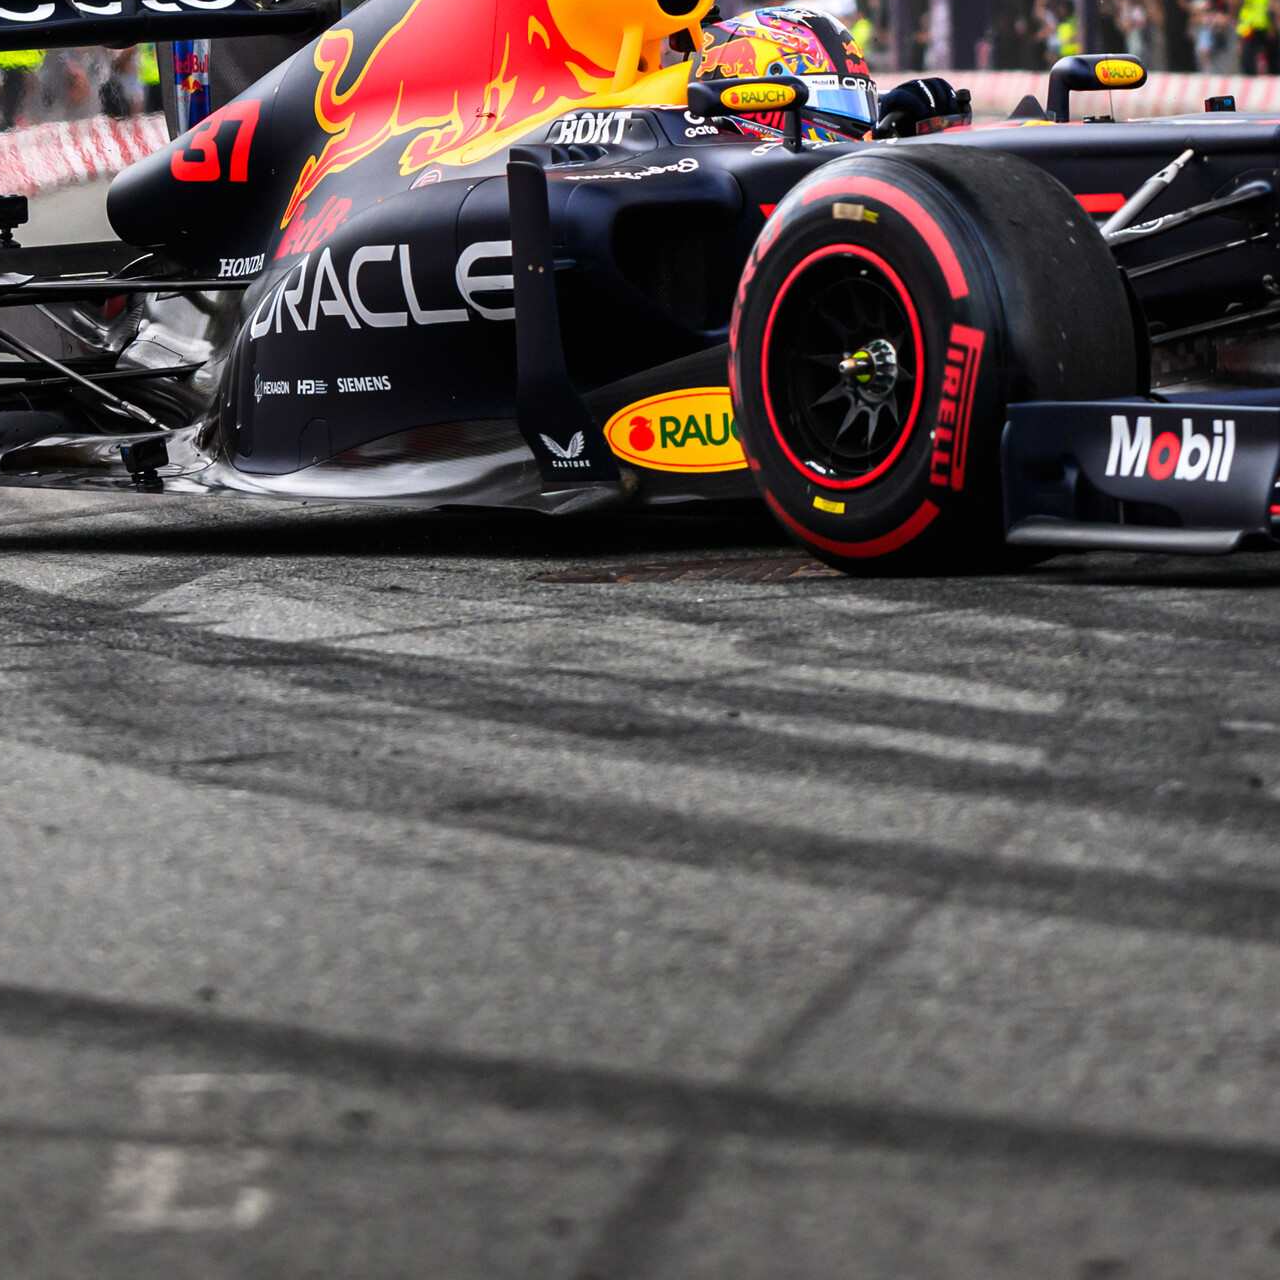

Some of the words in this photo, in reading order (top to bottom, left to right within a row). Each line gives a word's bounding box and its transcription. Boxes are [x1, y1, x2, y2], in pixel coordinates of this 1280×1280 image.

[741, 91, 786, 104] RAUCH
[171, 99, 262, 182] 37
[685, 124, 719, 138] Gate
[218, 253, 265, 277] HONDA
[250, 240, 516, 341] ORACLE
[263, 381, 290, 395] HEXAGON
[337, 375, 391, 393] SIEMENS
[929, 323, 986, 492] PIRELLI
[660, 413, 741, 448] RAU
[1105, 415, 1236, 482] Mobil
[552, 459, 591, 468] CASTORE
